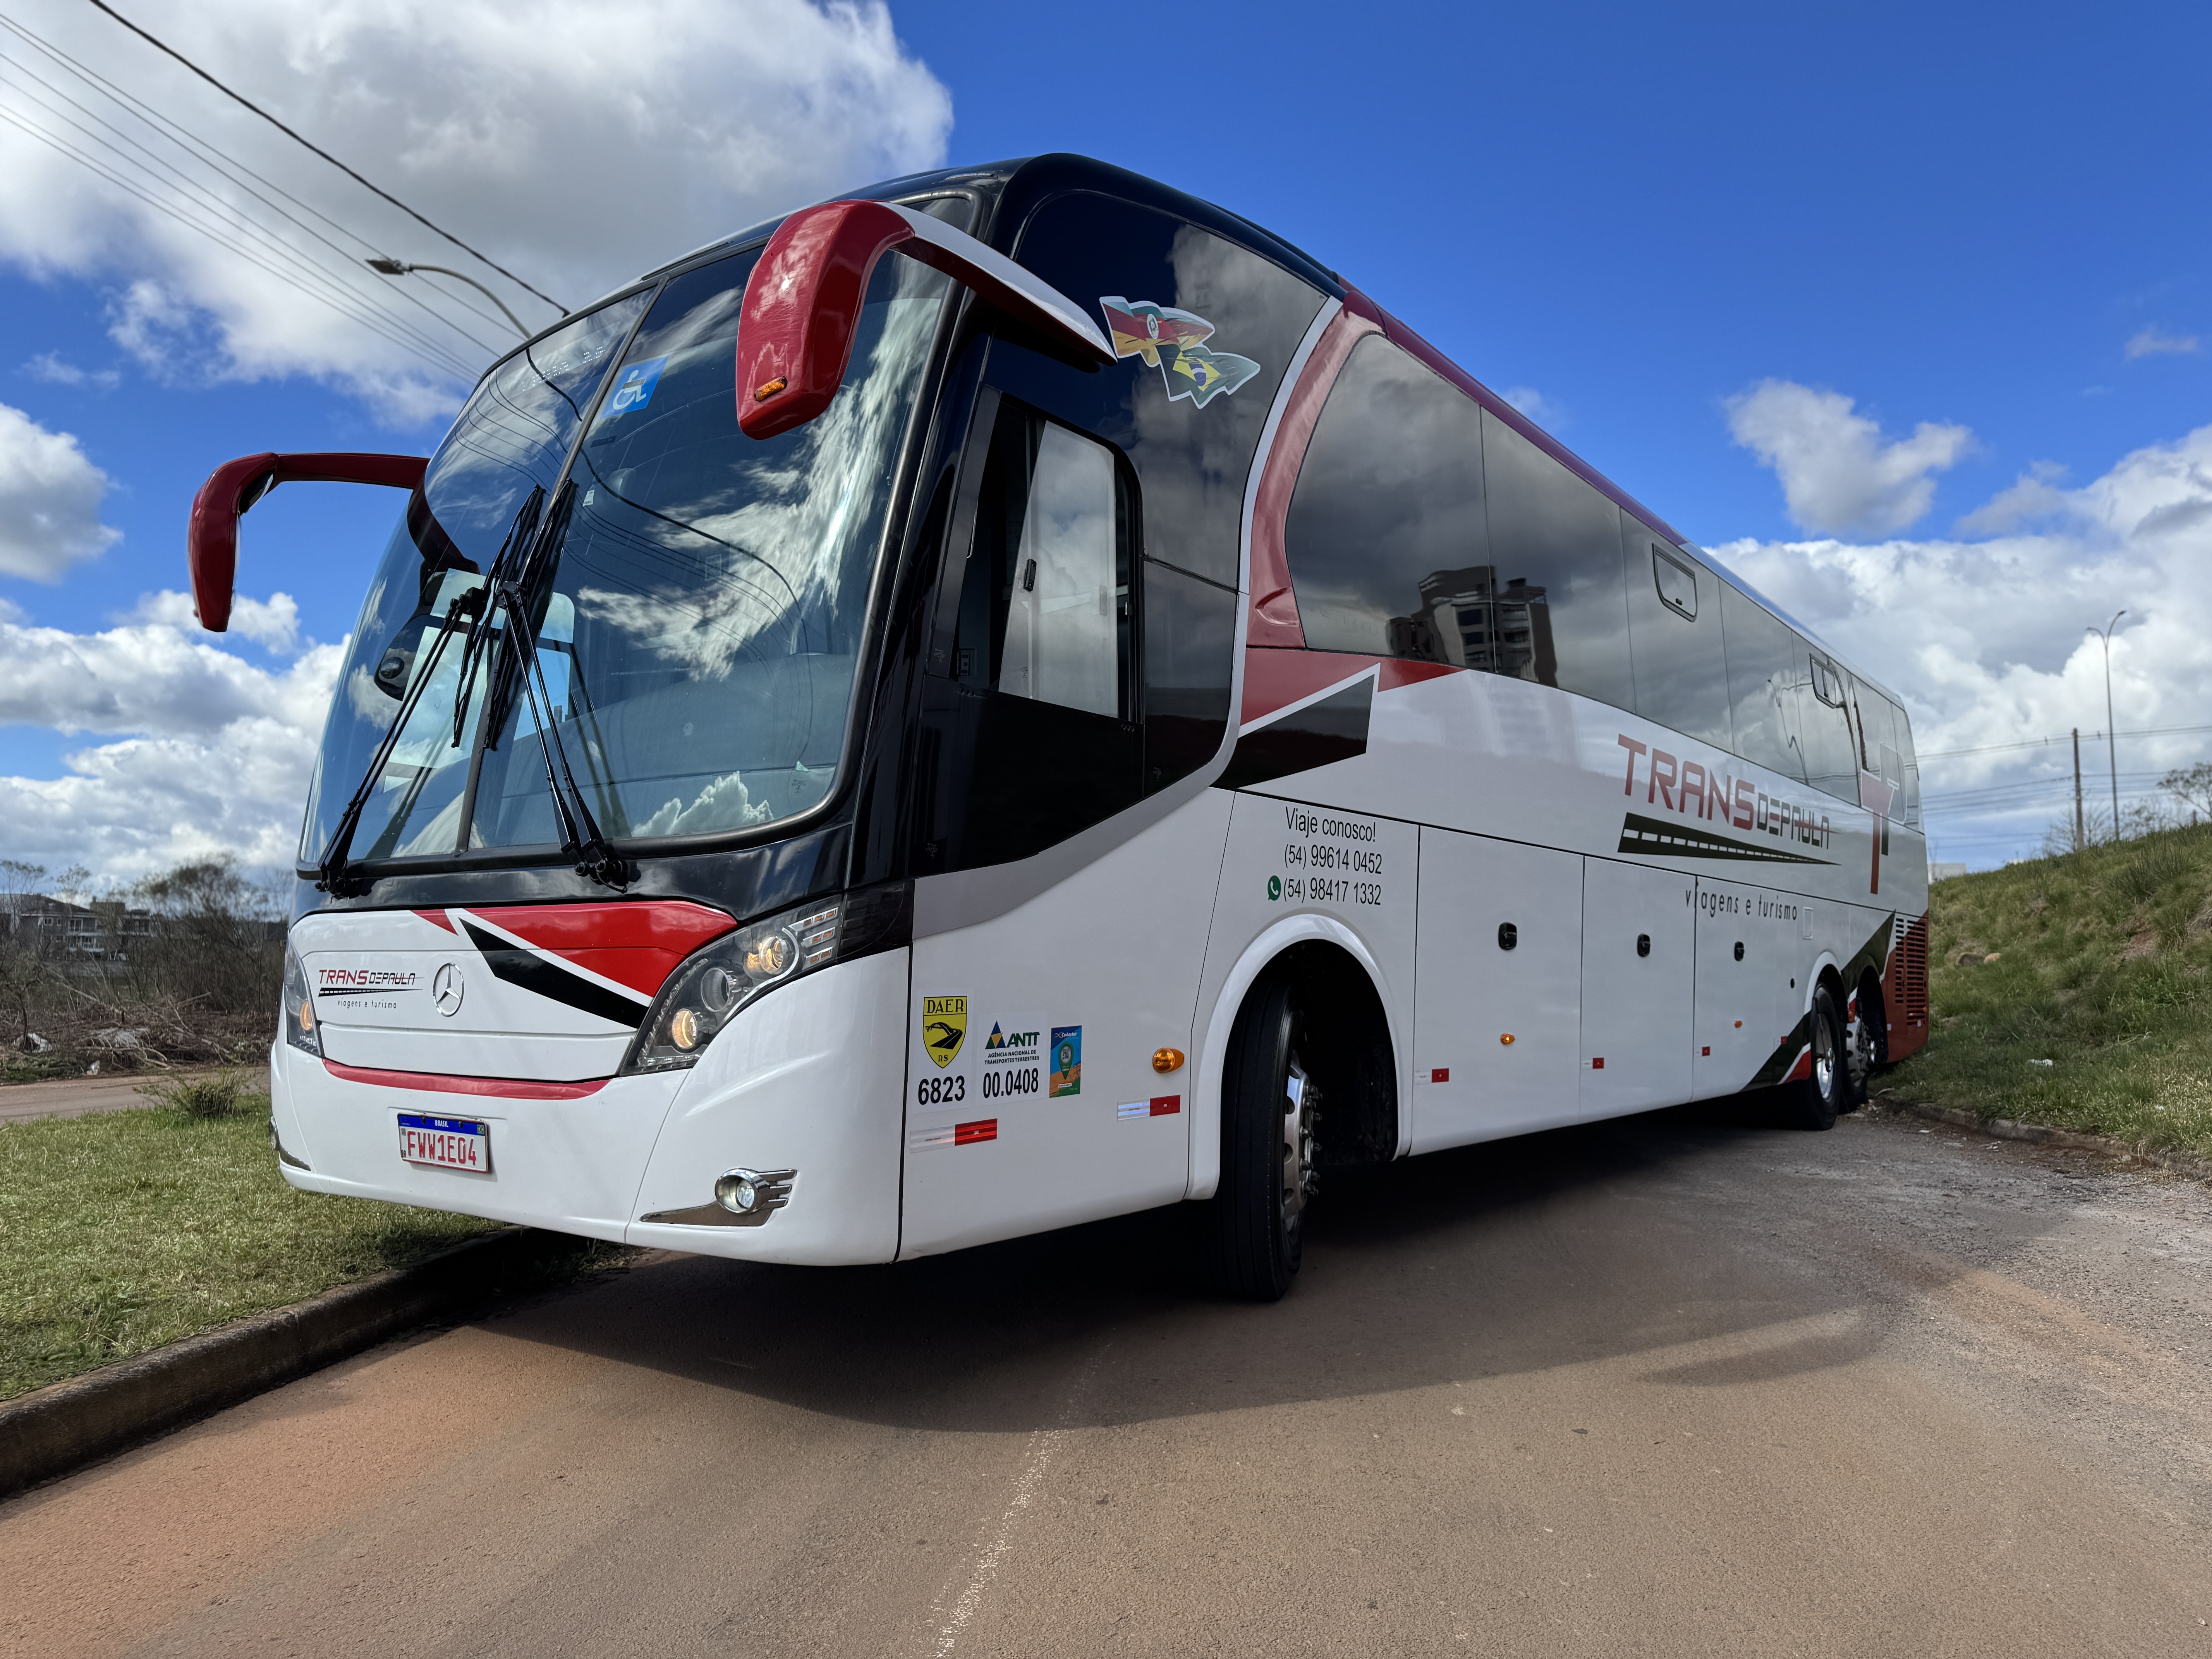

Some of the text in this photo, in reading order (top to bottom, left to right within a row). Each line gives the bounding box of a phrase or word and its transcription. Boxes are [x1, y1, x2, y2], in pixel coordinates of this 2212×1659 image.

[1285, 806, 1376, 842] Viaje conosco!
[1285, 844, 1382, 874] (54) 99614 0452
[1283, 877, 1381, 905] (54) 98417 1332
[1746, 899, 1751, 915] e
[1759, 894, 1797, 920] turismo
[338, 998, 361, 1009] viagens
[371, 1000, 397, 1009] turismo
[927, 999, 964, 1013] DAER
[1006, 1032, 1040, 1048] ANTT
[918, 1075, 965, 1105] 6823
[983, 1068, 1039, 1098] 00.0408
[435, 1119, 449, 1128] BRASIL
[407, 1131, 477, 1166] FWW1E04
